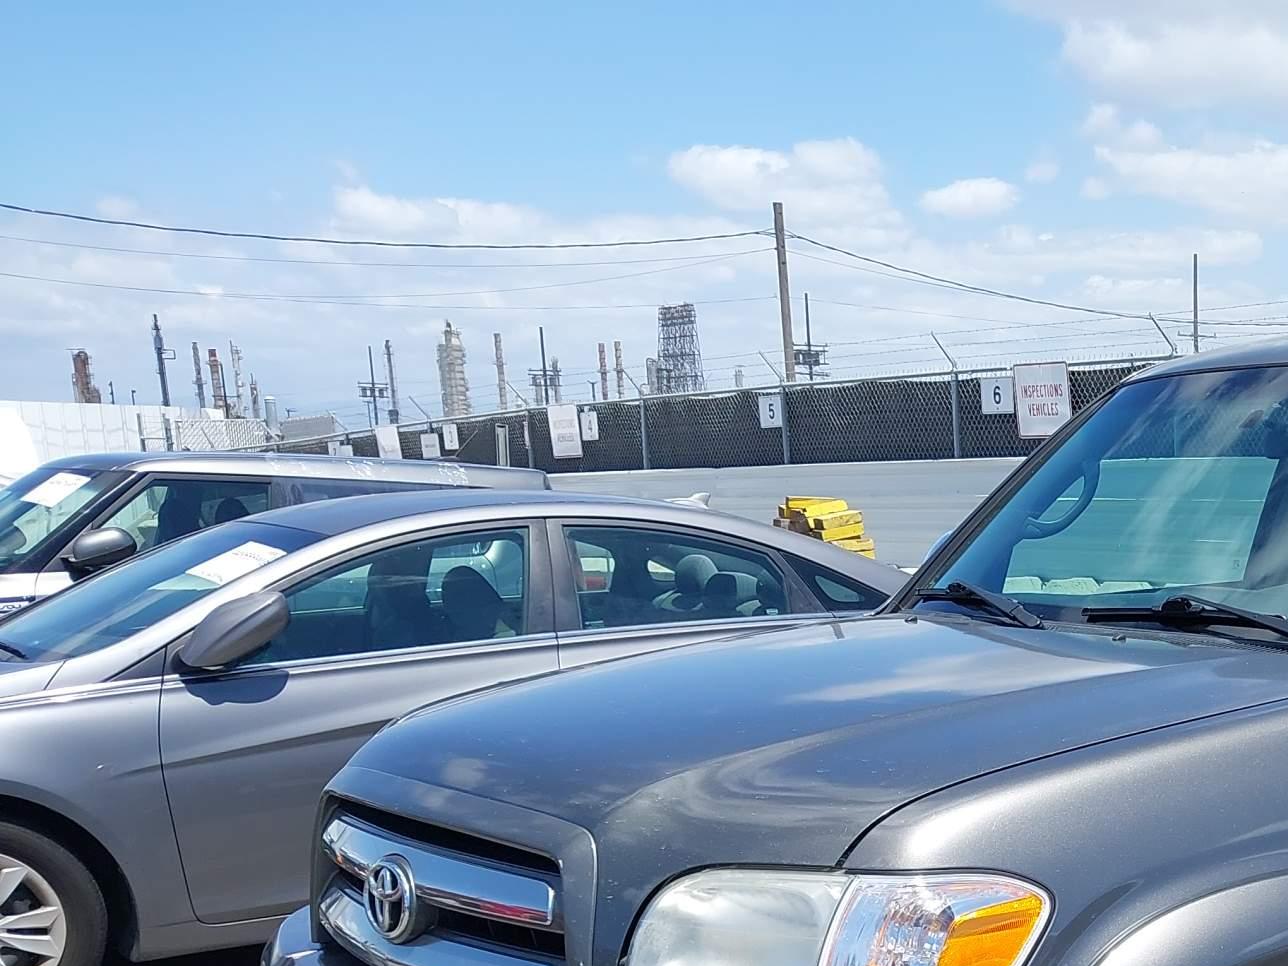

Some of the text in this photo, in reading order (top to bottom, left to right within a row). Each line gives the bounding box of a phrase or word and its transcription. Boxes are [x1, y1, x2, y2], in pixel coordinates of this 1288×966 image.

[993, 385, 1001, 405] 6
[1020, 384, 1063, 399] INSPECTIONS
[768, 403, 775, 420] 5
[1028, 402, 1059, 417] VEHICLES
